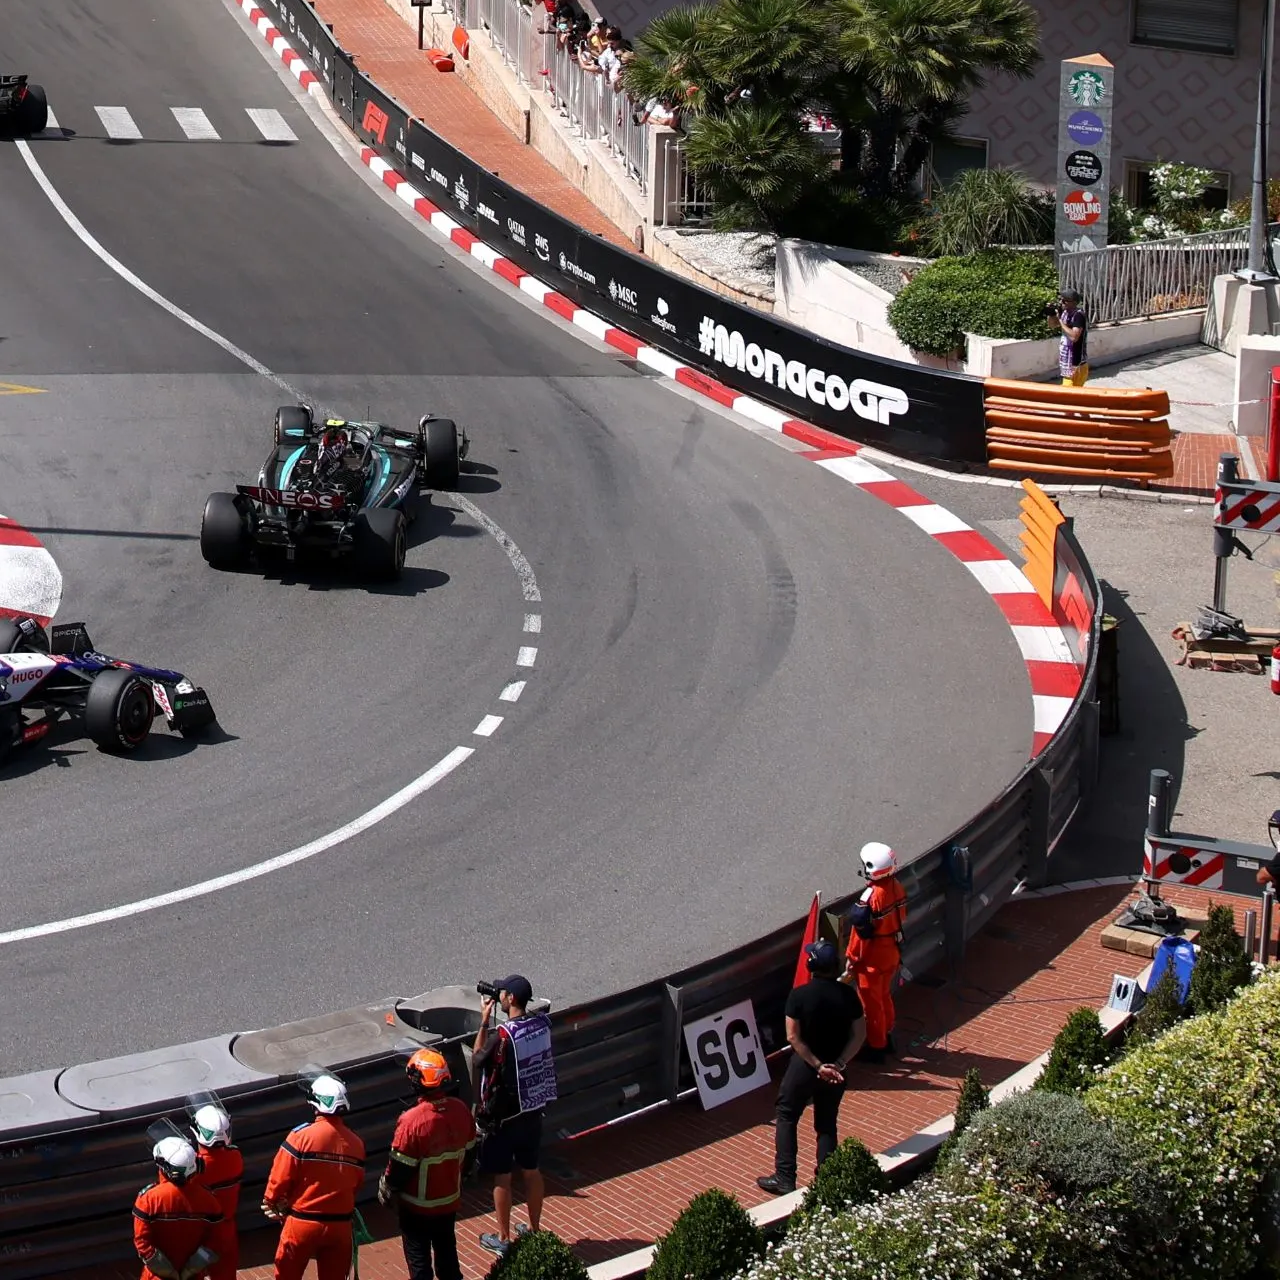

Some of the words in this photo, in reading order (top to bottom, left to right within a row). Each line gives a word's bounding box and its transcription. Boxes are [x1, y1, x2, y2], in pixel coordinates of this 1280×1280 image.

[1063, 202, 1102, 215] BOWLING
[616, 283, 638, 307] MSC
[698, 315, 910, 426] #MonacoGP
[257, 487, 335, 510] INEOS
[11, 668, 45, 684] HUGO
[696, 1018, 758, 1091] SC
